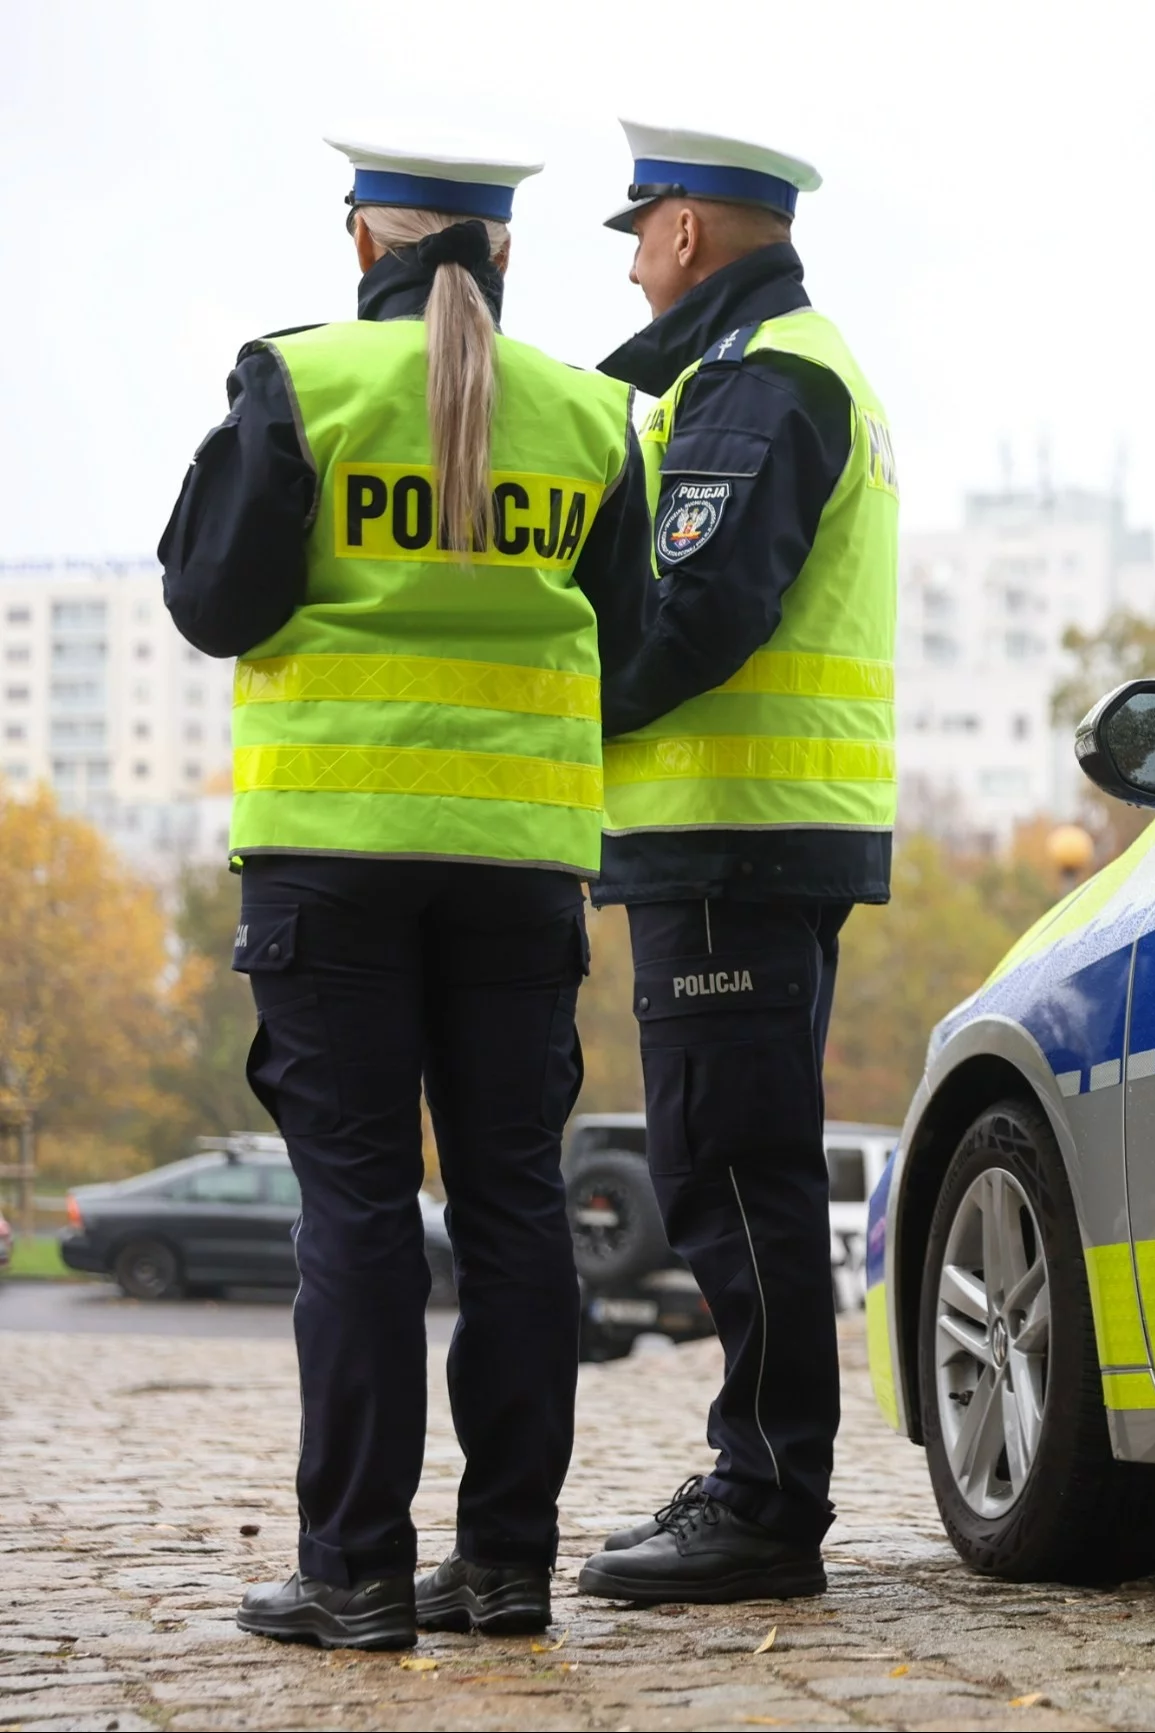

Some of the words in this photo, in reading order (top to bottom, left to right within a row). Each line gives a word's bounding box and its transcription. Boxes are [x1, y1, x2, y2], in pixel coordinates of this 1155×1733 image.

[678, 486, 726, 499] POLICJA
[347, 474, 586, 560] POCJA
[673, 970, 753, 998] POLICJA
